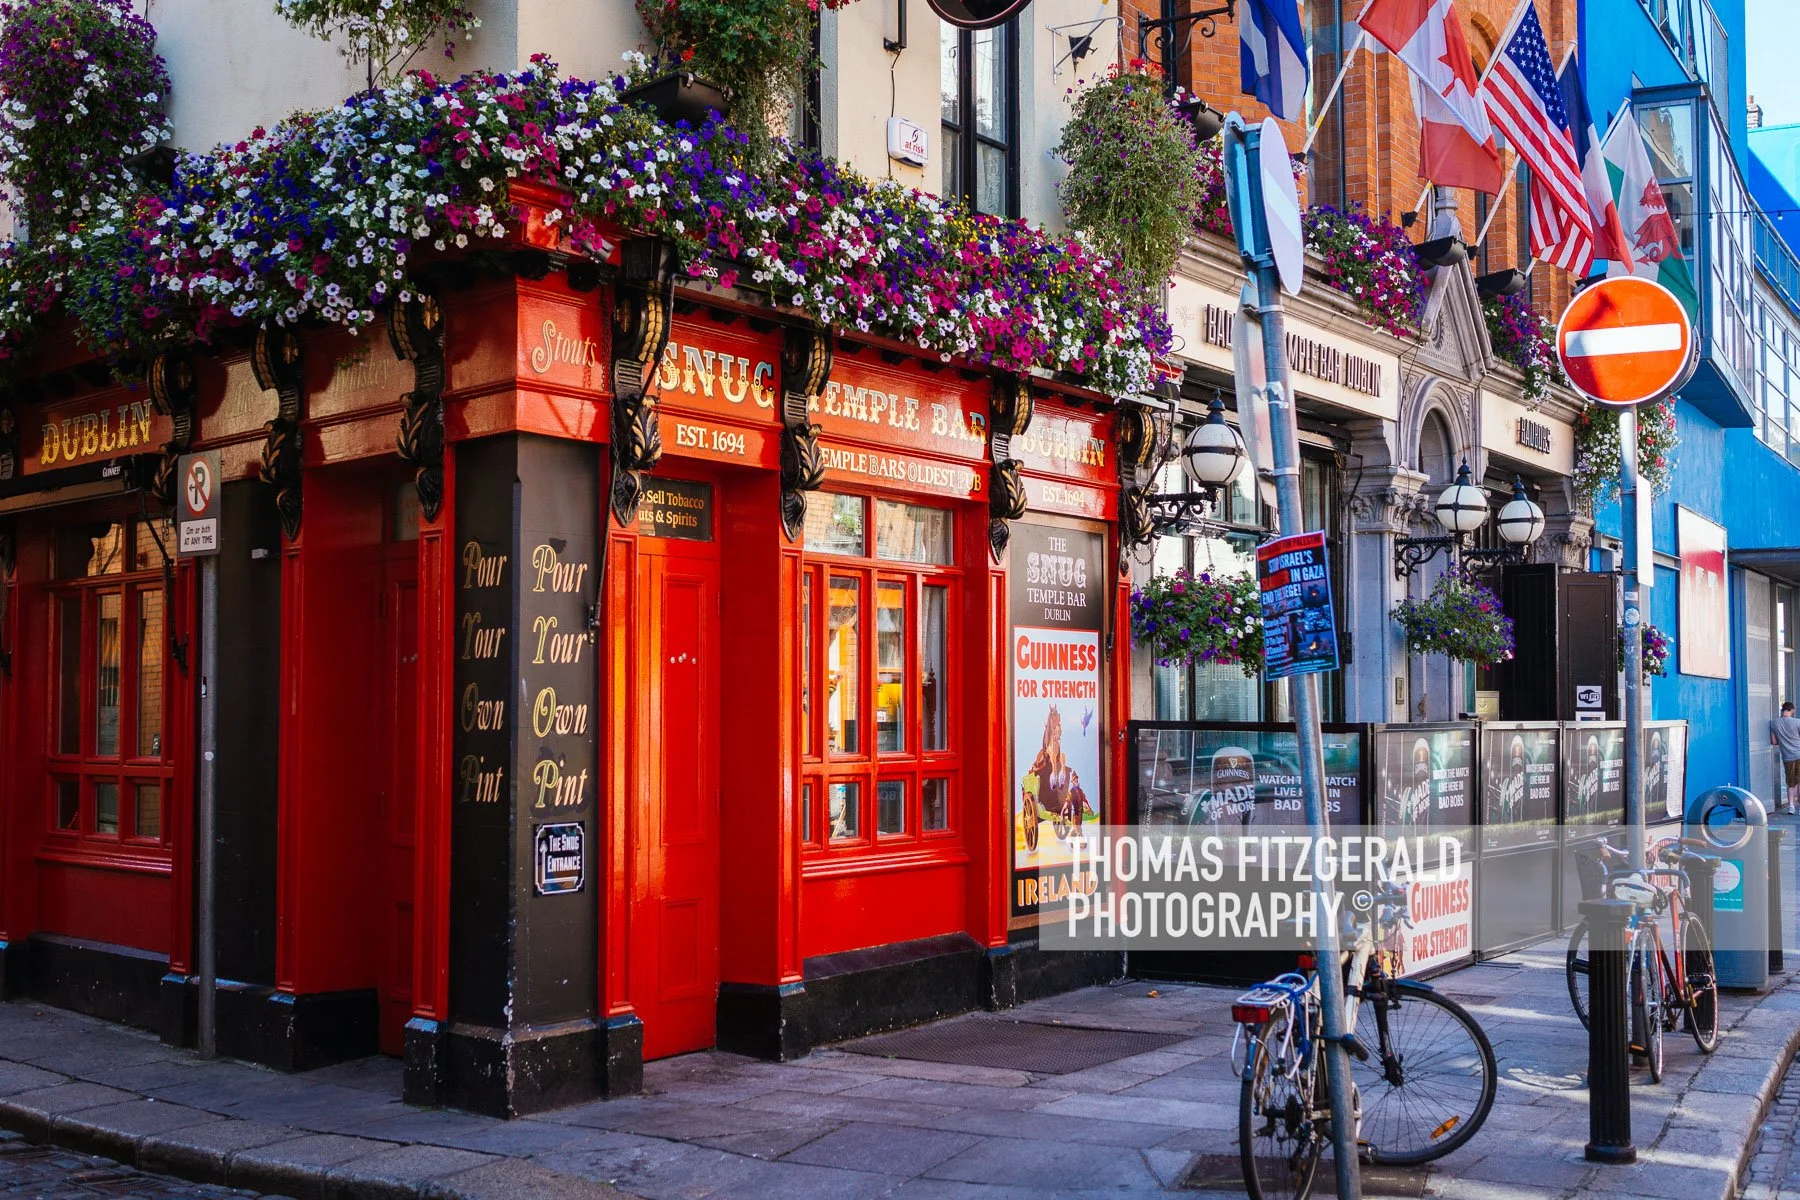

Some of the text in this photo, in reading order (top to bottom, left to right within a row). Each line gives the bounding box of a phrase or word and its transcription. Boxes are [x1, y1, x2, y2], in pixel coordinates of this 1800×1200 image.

[904, 141, 911, 150] at
[913, 143, 924, 155] risk
[531, 319, 597, 373] Stouts
[654, 341, 775, 409] SNUG
[1286, 331, 1319, 376] MPLE
[1345, 352, 1382, 398] DUBLIN
[41, 399, 153, 465] DUBLIN
[931, 402, 988, 445] BAR
[676, 424, 746, 455] EST. 1694
[1018, 427, 1106, 468] DUBLIN
[822, 446, 982, 493] EMPLE BARS OLDEST PUB
[646, 490, 665, 505] Sell
[666, 492, 705, 509] Tobacco
[1042, 485, 1085, 507] EST. 1694
[656, 510, 664, 523] &
[666, 511, 698, 528] Spirits
[184, 535, 213, 546] AT ANY TIME
[1048, 536, 1067, 552] THE
[462, 541, 507, 589] Pour
[532, 544, 588, 592] Pour
[1027, 551, 1087, 588] SNUG
[1290, 568, 1301, 583] IN
[1302, 564, 1325, 581] GAZA
[1027, 587, 1087, 607] TEMPLE BAR
[1262, 590, 1274, 605] END
[1044, 608, 1071, 621] DUBLIN
[461, 612, 505, 660] Your
[532, 616, 588, 664] Your
[1016, 635, 1096, 672] GUINNESS
[1017, 679, 1096, 699] FOR STRENGTH
[461, 682, 504, 732] Own
[533, 686, 588, 737] Own
[461, 754, 503, 802] Pint
[533, 759, 588, 808] Pint
[1217, 769, 1250, 780] GUINNESS
[1259, 775, 1295, 785] WATCH
[1210, 785, 1255, 810] MADE
[1274, 786, 1297, 796] LIVE
[1328, 788, 1341, 798] IN
[1274, 799, 1341, 813] BAD BS
[1438, 794, 1464, 810] BAD BOBS
[1211, 800, 1256, 820] OF MORE
[549, 834, 580, 852] THE SNUG
[547, 856, 582, 873] ENTRANCE
[1018, 870, 1099, 907] IRELAND
[1411, 879, 1469, 924] GUINNESS
[1412, 923, 1468, 962] FOR STRENGTH
